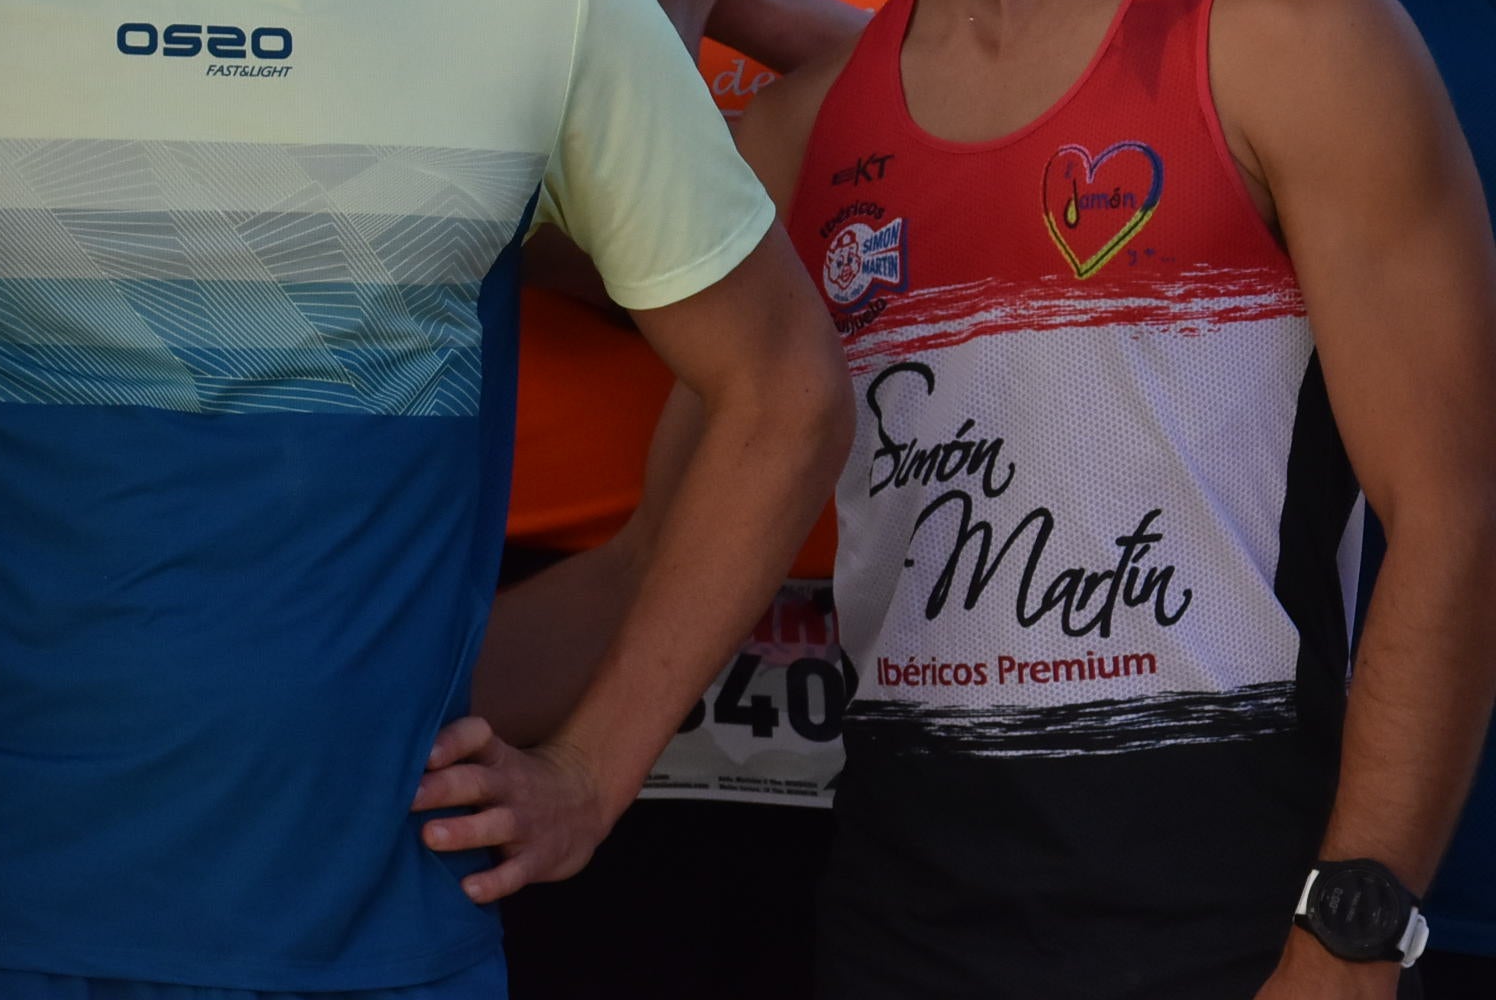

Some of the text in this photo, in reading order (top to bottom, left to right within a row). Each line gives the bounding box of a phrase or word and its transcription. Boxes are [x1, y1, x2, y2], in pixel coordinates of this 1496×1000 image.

[206, 64, 293, 78] FAST&LIGHT
[862, 222, 901, 255] SIMON
[862, 254, 899, 281] MARTIN
[865, 362, 1015, 498] Simón
[905, 488, 1193, 639] Martín
[876, 650, 1158, 687] Ibéricos Premium
